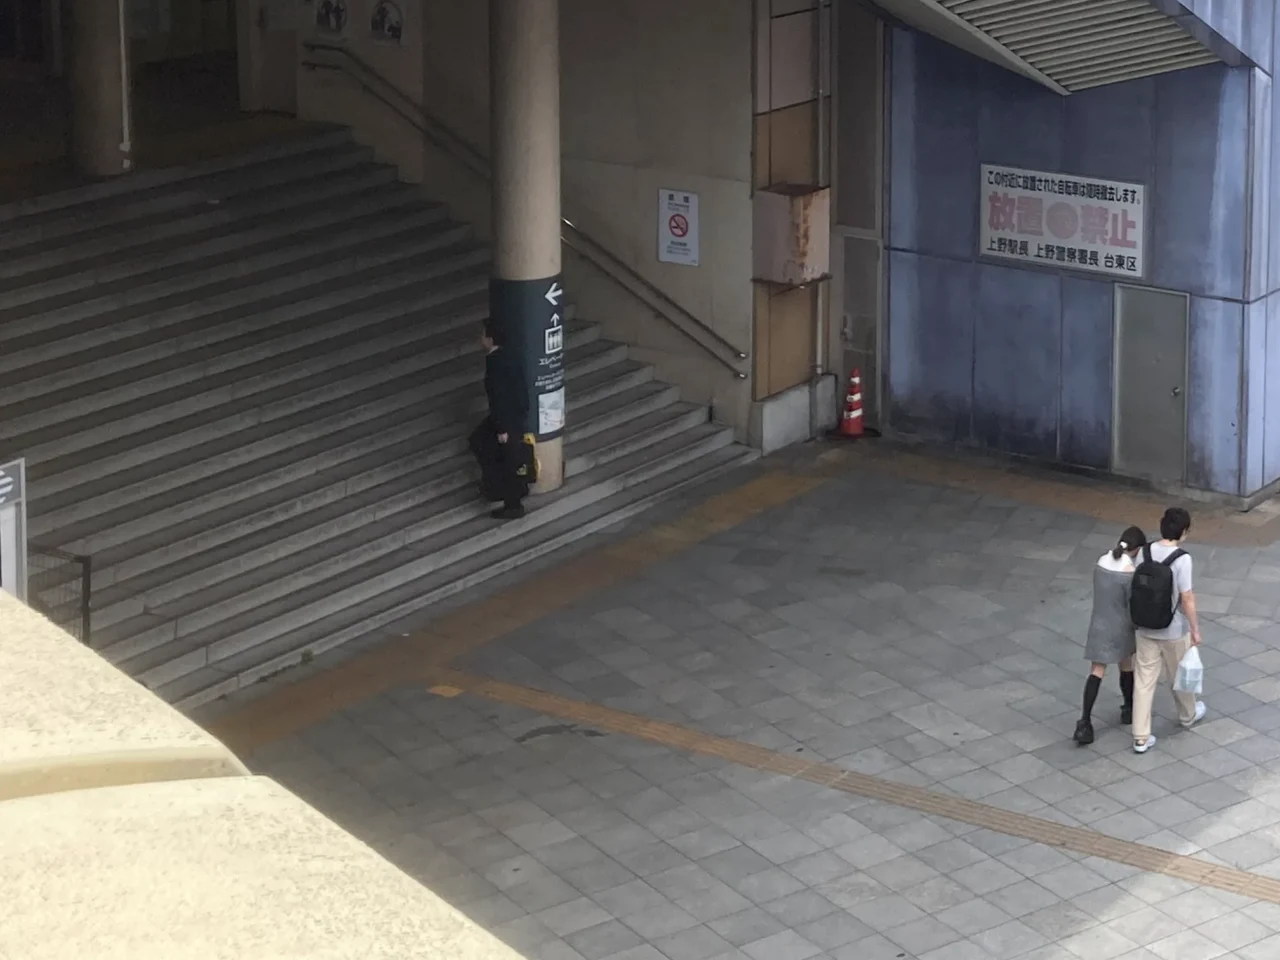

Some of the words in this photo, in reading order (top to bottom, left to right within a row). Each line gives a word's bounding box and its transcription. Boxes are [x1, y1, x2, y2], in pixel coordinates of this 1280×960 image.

[988, 191, 1044, 237] 放置
[1080, 203, 1137, 249] 禁止
[986, 235, 1029, 256] 上野駅長
[1033, 242, 1099, 267] 上野警察署長
[1103, 252, 1138, 272] 台東区
